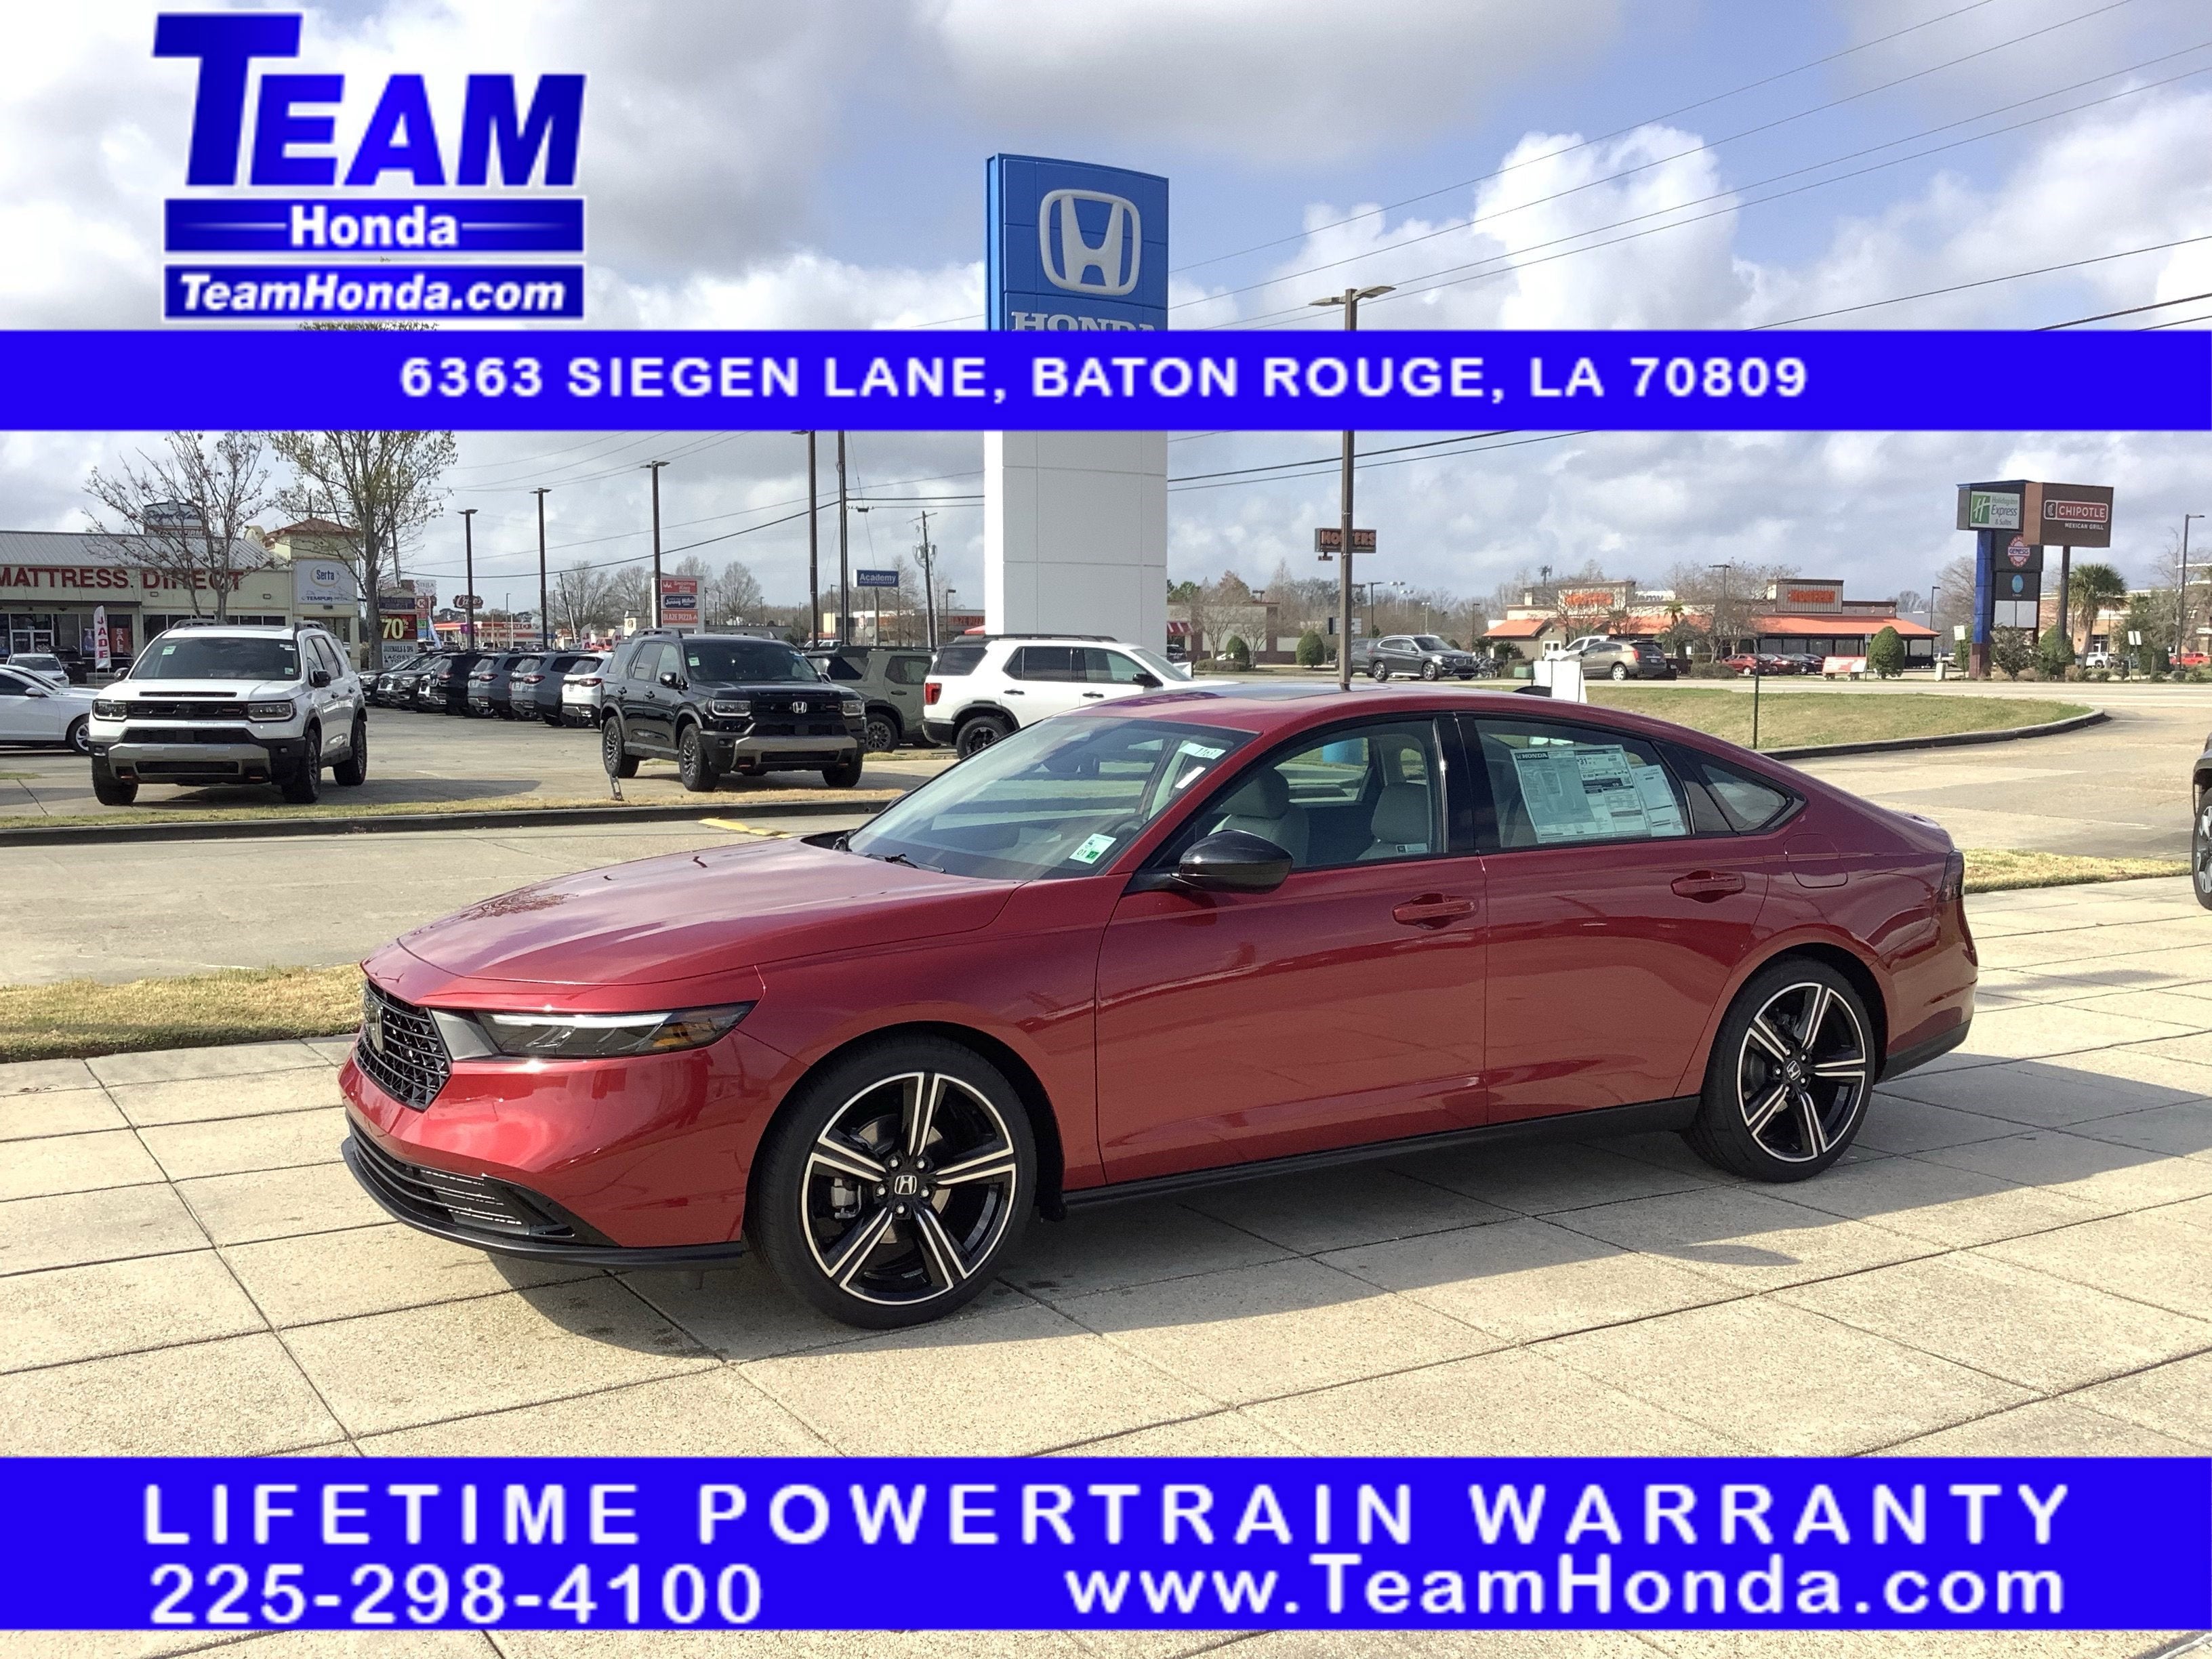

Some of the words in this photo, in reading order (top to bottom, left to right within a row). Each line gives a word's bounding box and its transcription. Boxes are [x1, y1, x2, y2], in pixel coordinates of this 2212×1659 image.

[1991, 504, 2018, 518] Express
[2059, 506, 2106, 518] CHIPOTLE
[1321, 531, 1375, 546] HOERS
[316, 569, 335, 580] Serta
[859, 573, 897, 583] Academy
[456, 595, 482, 607] Cae's
[1522, 750, 1548, 758] HONDA
